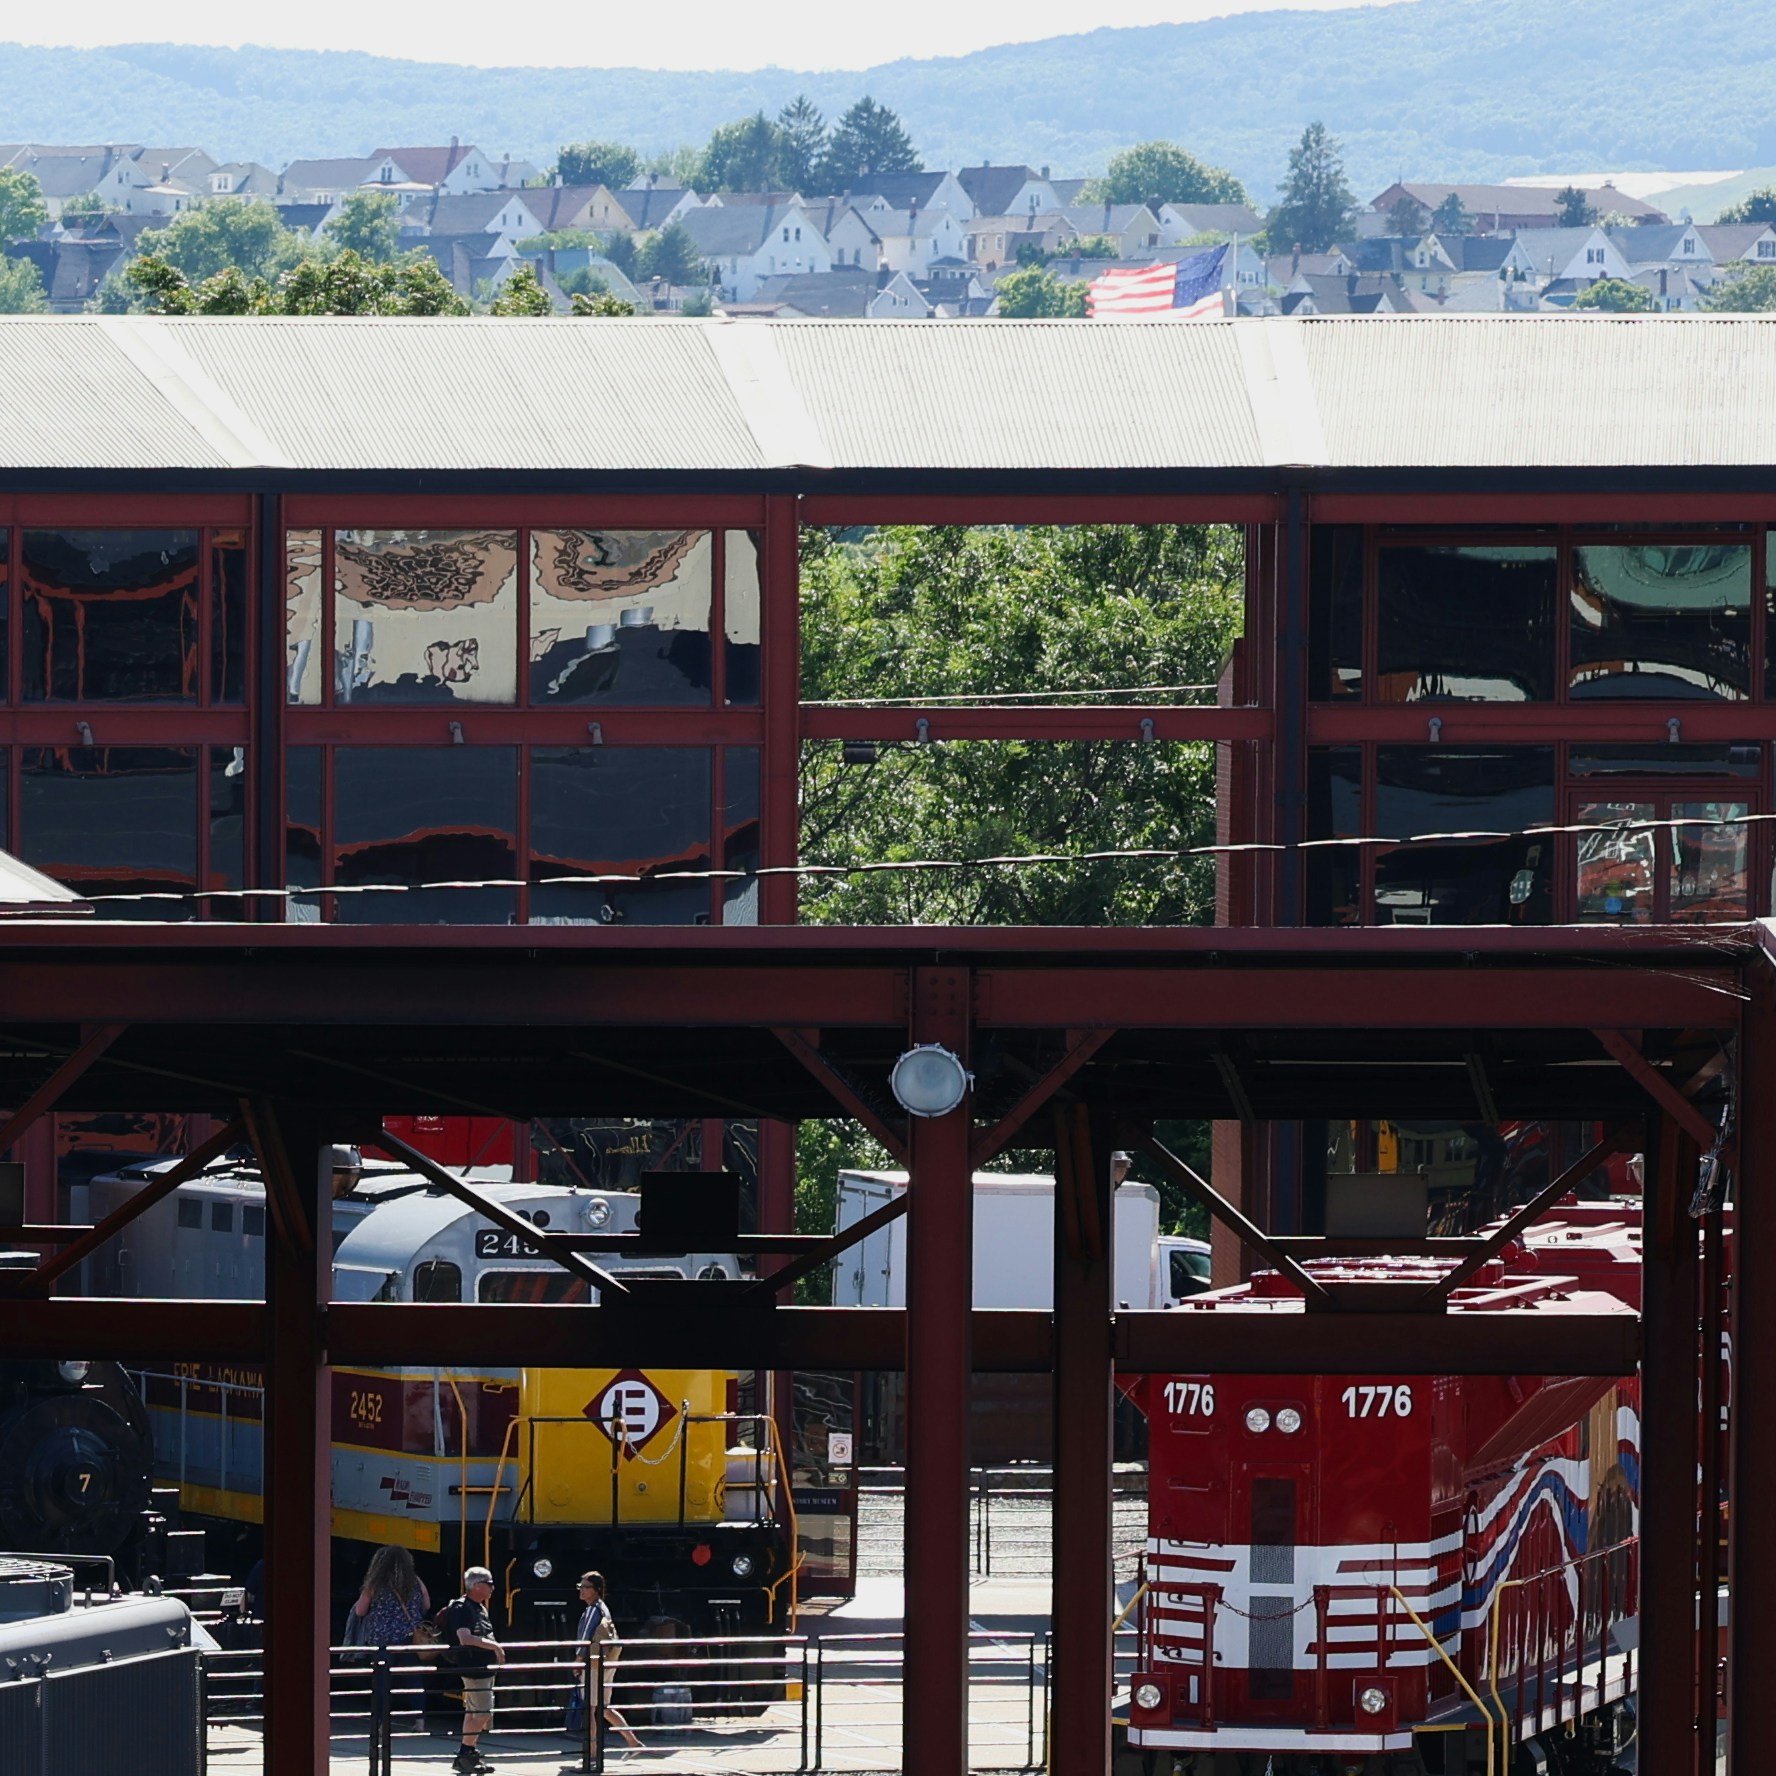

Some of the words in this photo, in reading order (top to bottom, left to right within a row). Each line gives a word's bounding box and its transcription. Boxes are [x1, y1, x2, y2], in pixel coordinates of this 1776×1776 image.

[350, 1390, 383, 1423] 2452
[1163, 1382, 1215, 1417] 1776
[1341, 1384, 1413, 1419] 1776
[78, 1473, 92, 1493] 7
